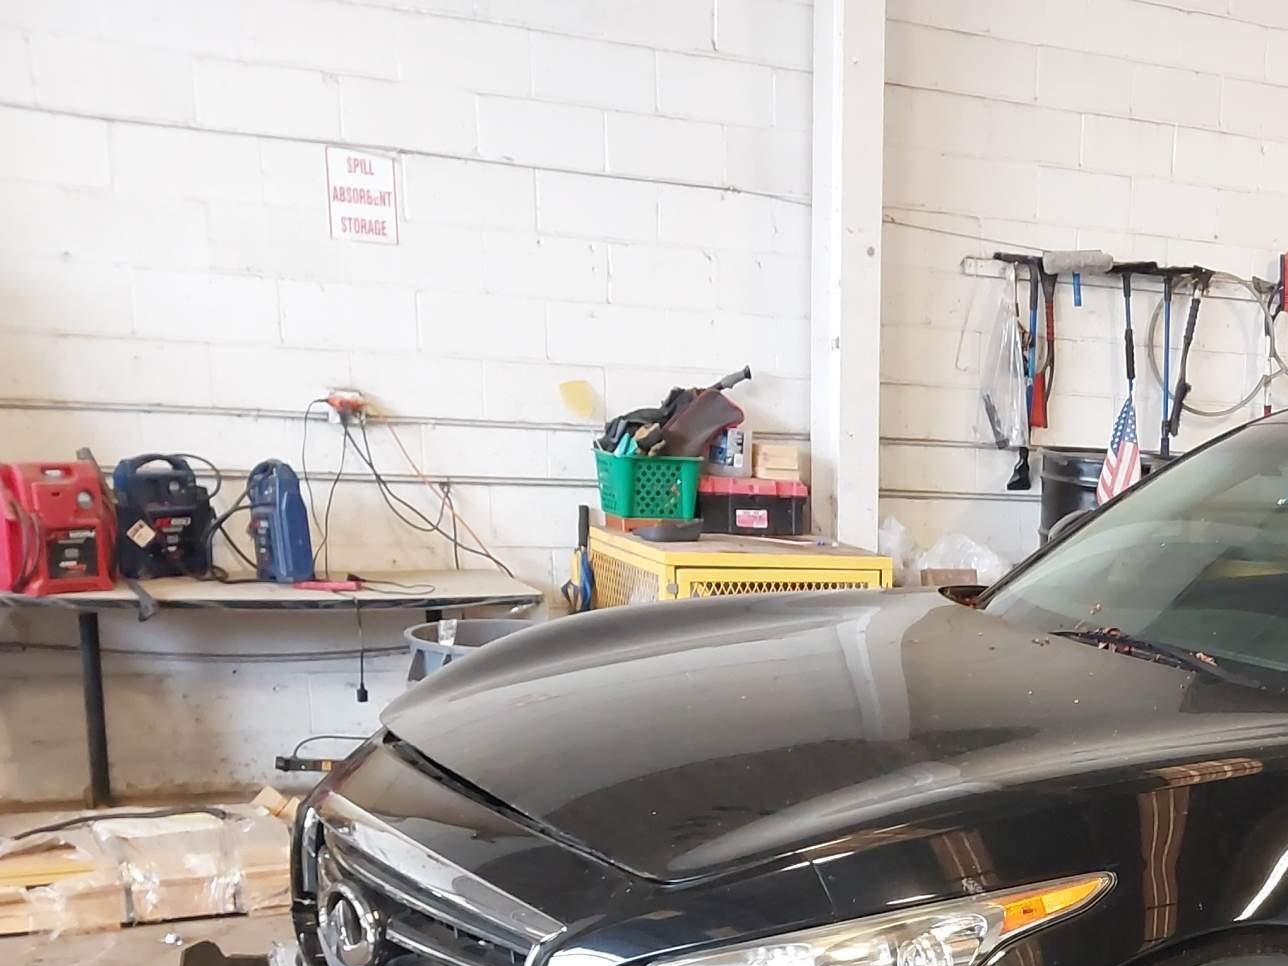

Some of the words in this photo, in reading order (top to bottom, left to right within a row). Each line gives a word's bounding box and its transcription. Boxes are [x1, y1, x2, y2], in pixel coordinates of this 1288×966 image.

[346, 156, 375, 175] SPILL
[332, 185, 392, 208] ABSORBENT
[340, 216, 388, 236] STORAGE
